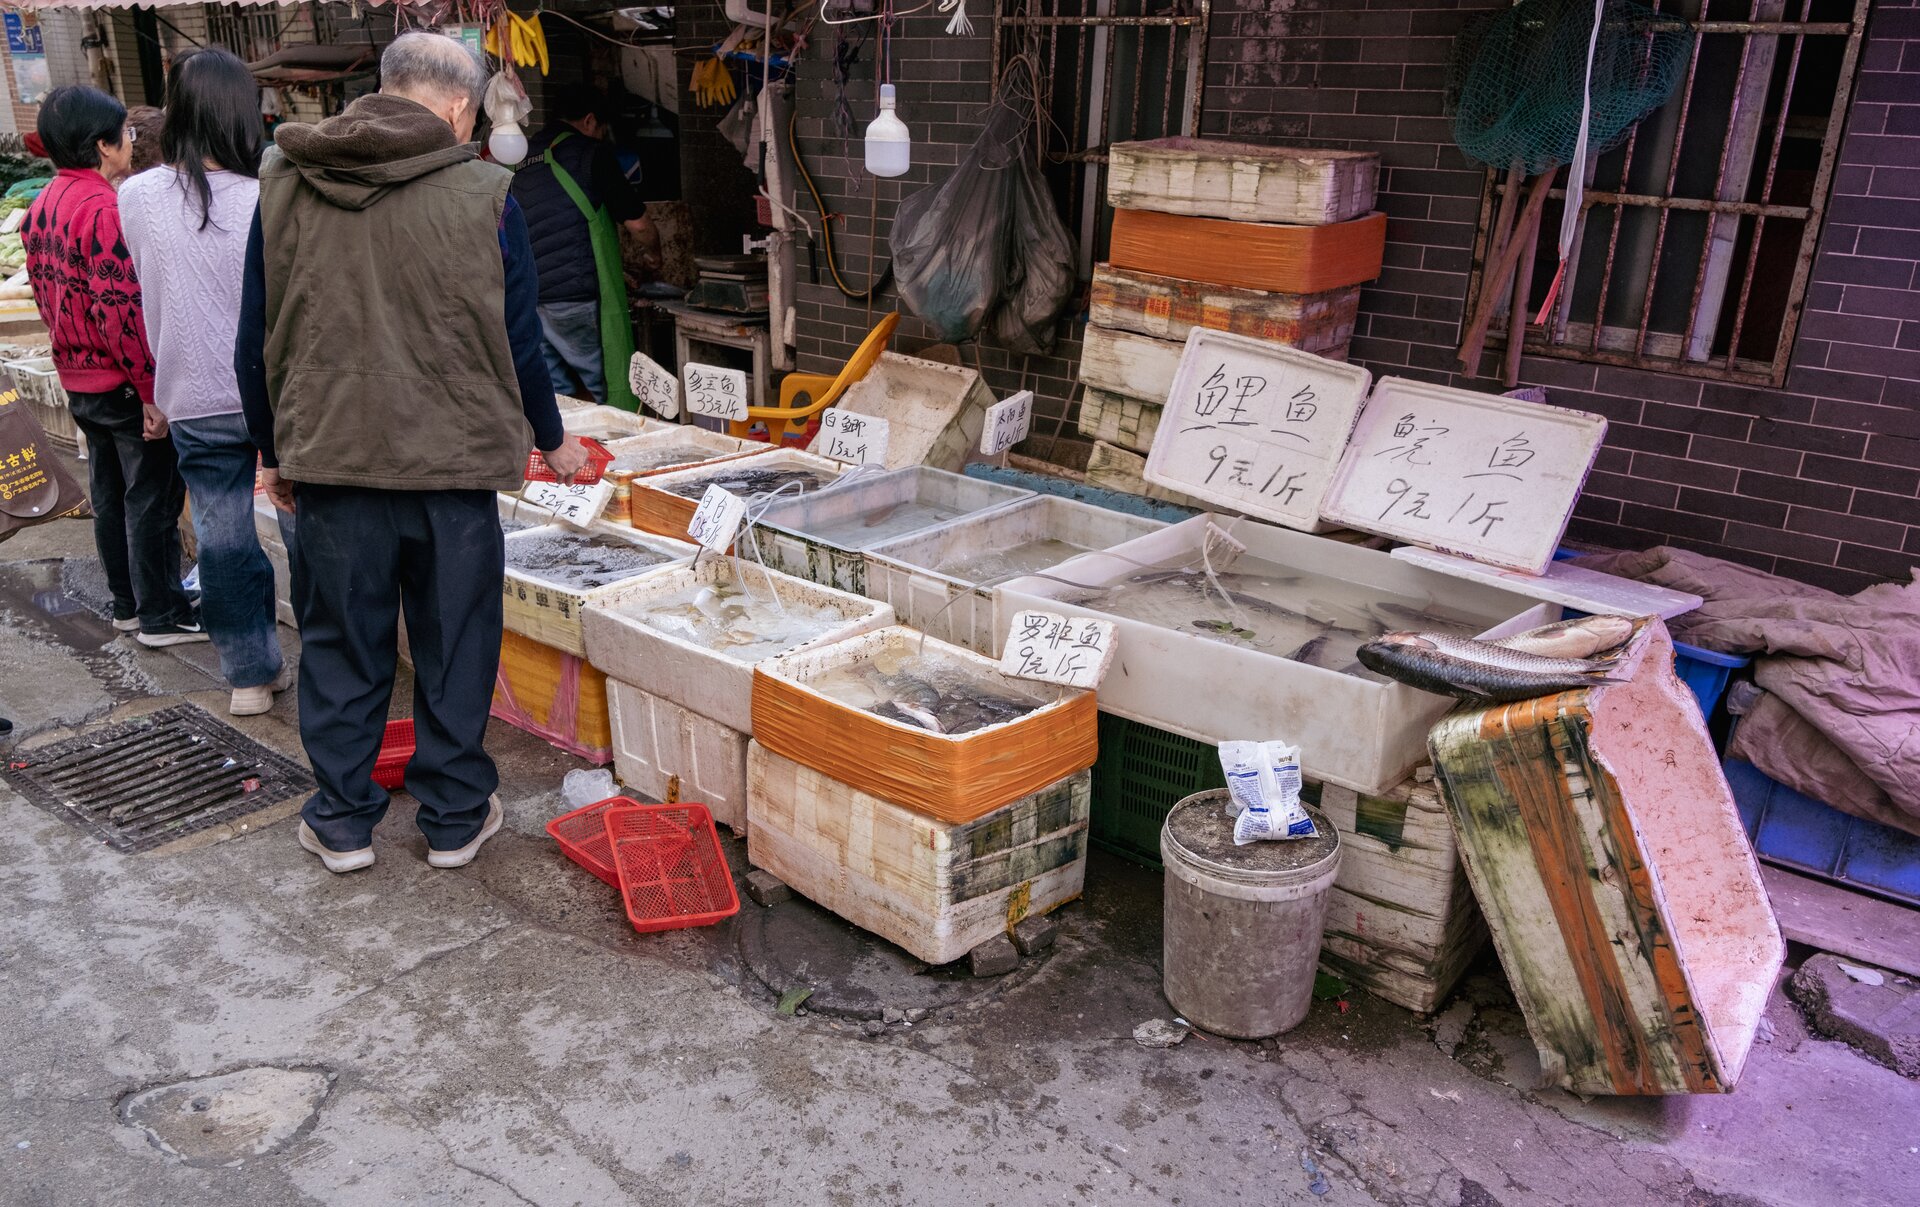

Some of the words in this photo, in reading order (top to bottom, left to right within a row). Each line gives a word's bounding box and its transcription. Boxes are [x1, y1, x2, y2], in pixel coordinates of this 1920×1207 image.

[528, 154, 544, 166] FISH
[688, 370, 739, 398] 多宝鱼
[997, 400, 1026, 427] 太阳鱼
[1180, 363, 1317, 443] 鲤鱼
[1373, 413, 1536, 482] 鲩鱼
[1018, 615, 1102, 653] 罗非鱼
